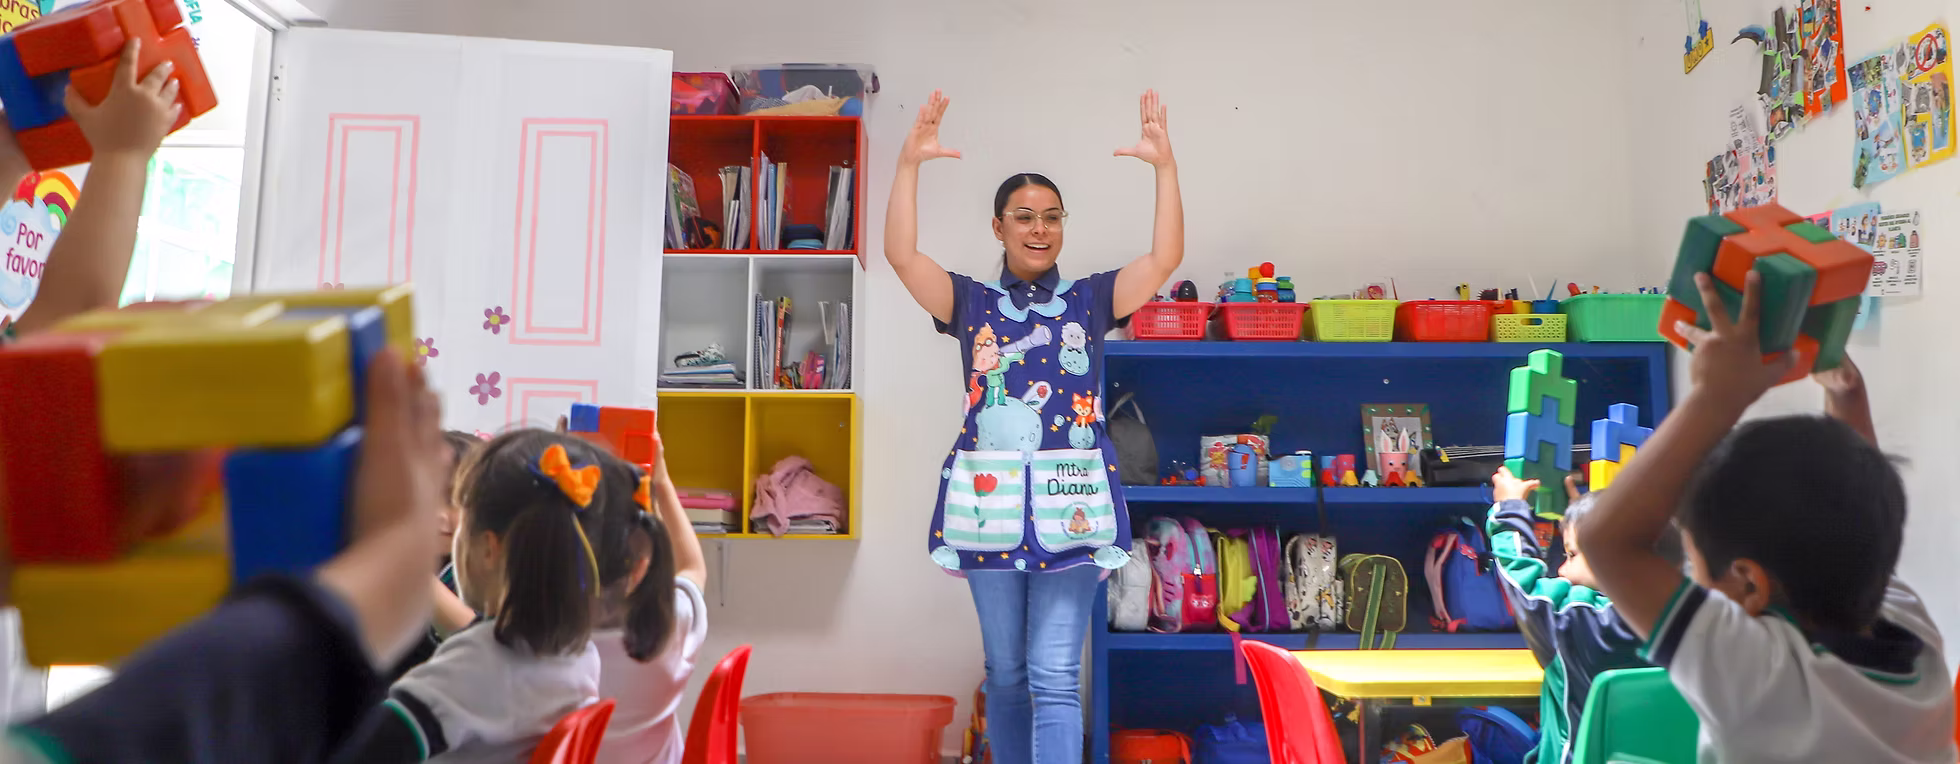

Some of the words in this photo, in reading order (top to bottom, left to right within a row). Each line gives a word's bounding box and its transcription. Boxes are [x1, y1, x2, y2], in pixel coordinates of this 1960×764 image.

[16, 222, 44, 250] Por
[6, 247, 47, 279] favor
[1056, 462, 1089, 477] Mtra
[1047, 478, 1099, 496] Diana
